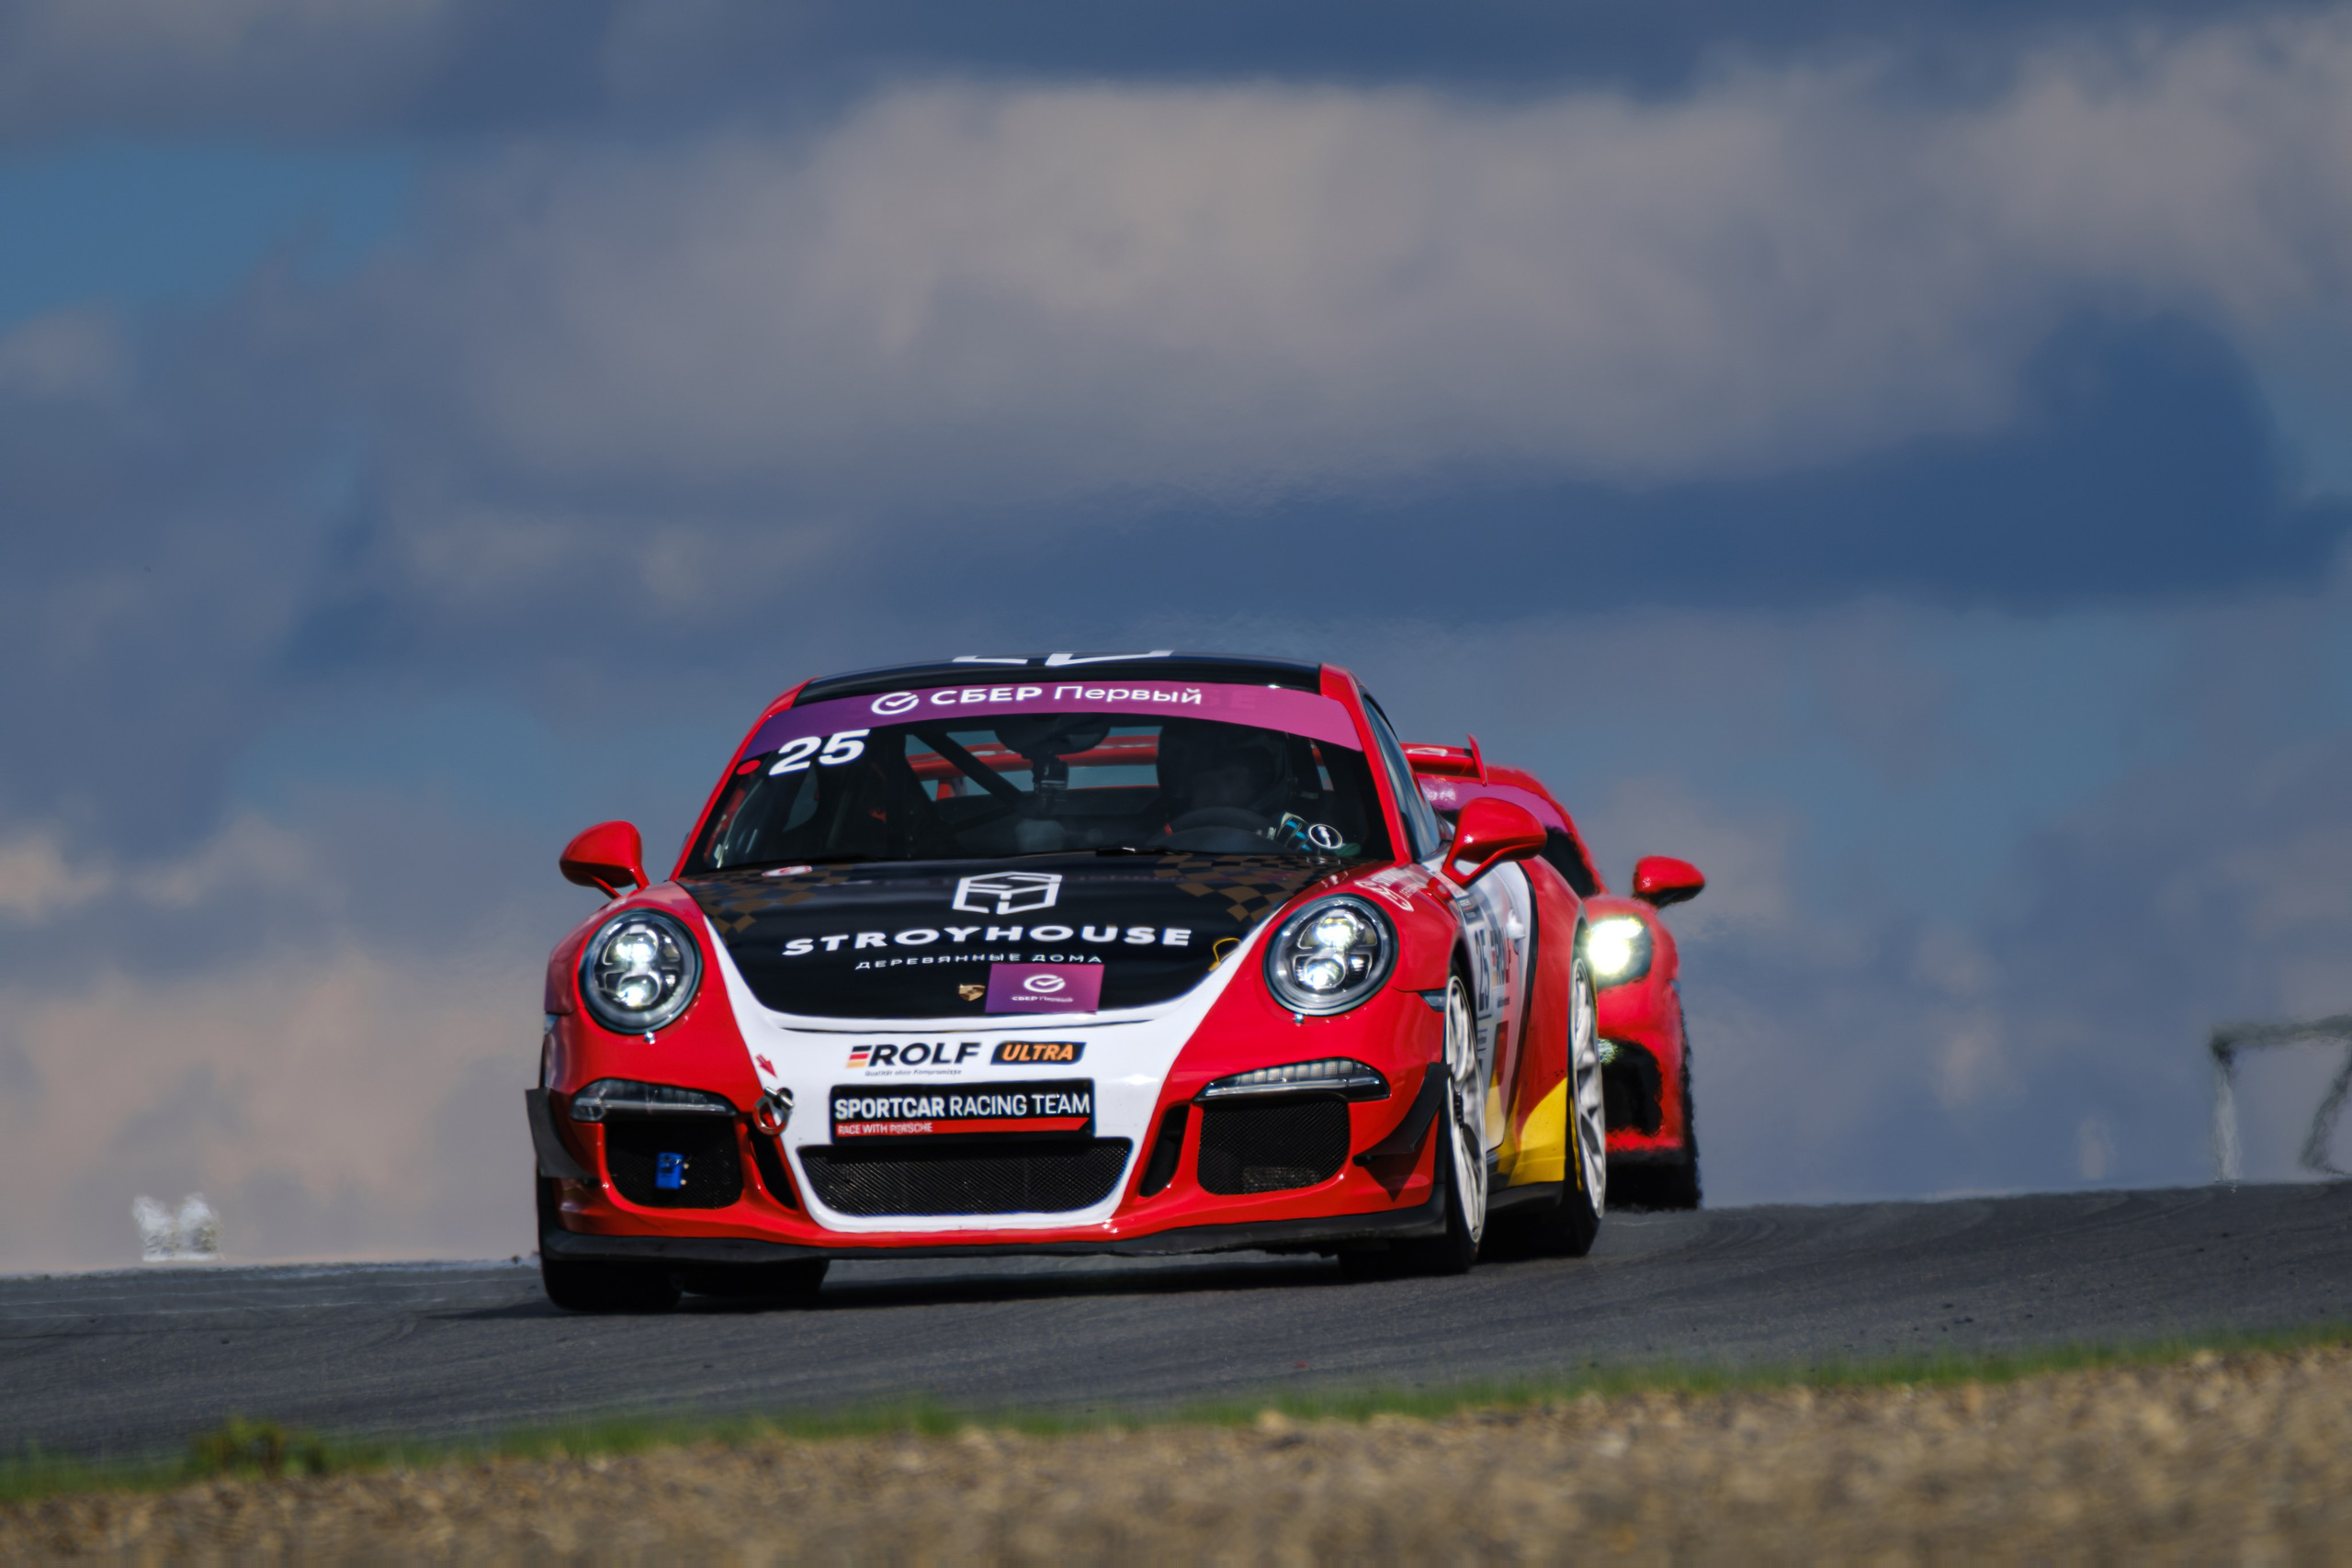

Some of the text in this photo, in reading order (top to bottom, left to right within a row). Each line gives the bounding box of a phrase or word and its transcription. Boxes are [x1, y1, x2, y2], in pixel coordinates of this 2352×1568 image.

[930, 686, 1043, 705] СБЕР
[1053, 685, 1203, 705] Первый
[768, 728, 871, 777] 25
[782, 924, 1193, 956] STROYHOUSE
[854, 953, 1103, 970] ДЕРЕВЯННЫЕ ДОМА
[868, 1042, 1074, 1067] ROLF ULTRA
[834, 1093, 1091, 1120] SPORTCAR RACING TEAM
[838, 1122, 933, 1134] RACE WITH PORSCHE
